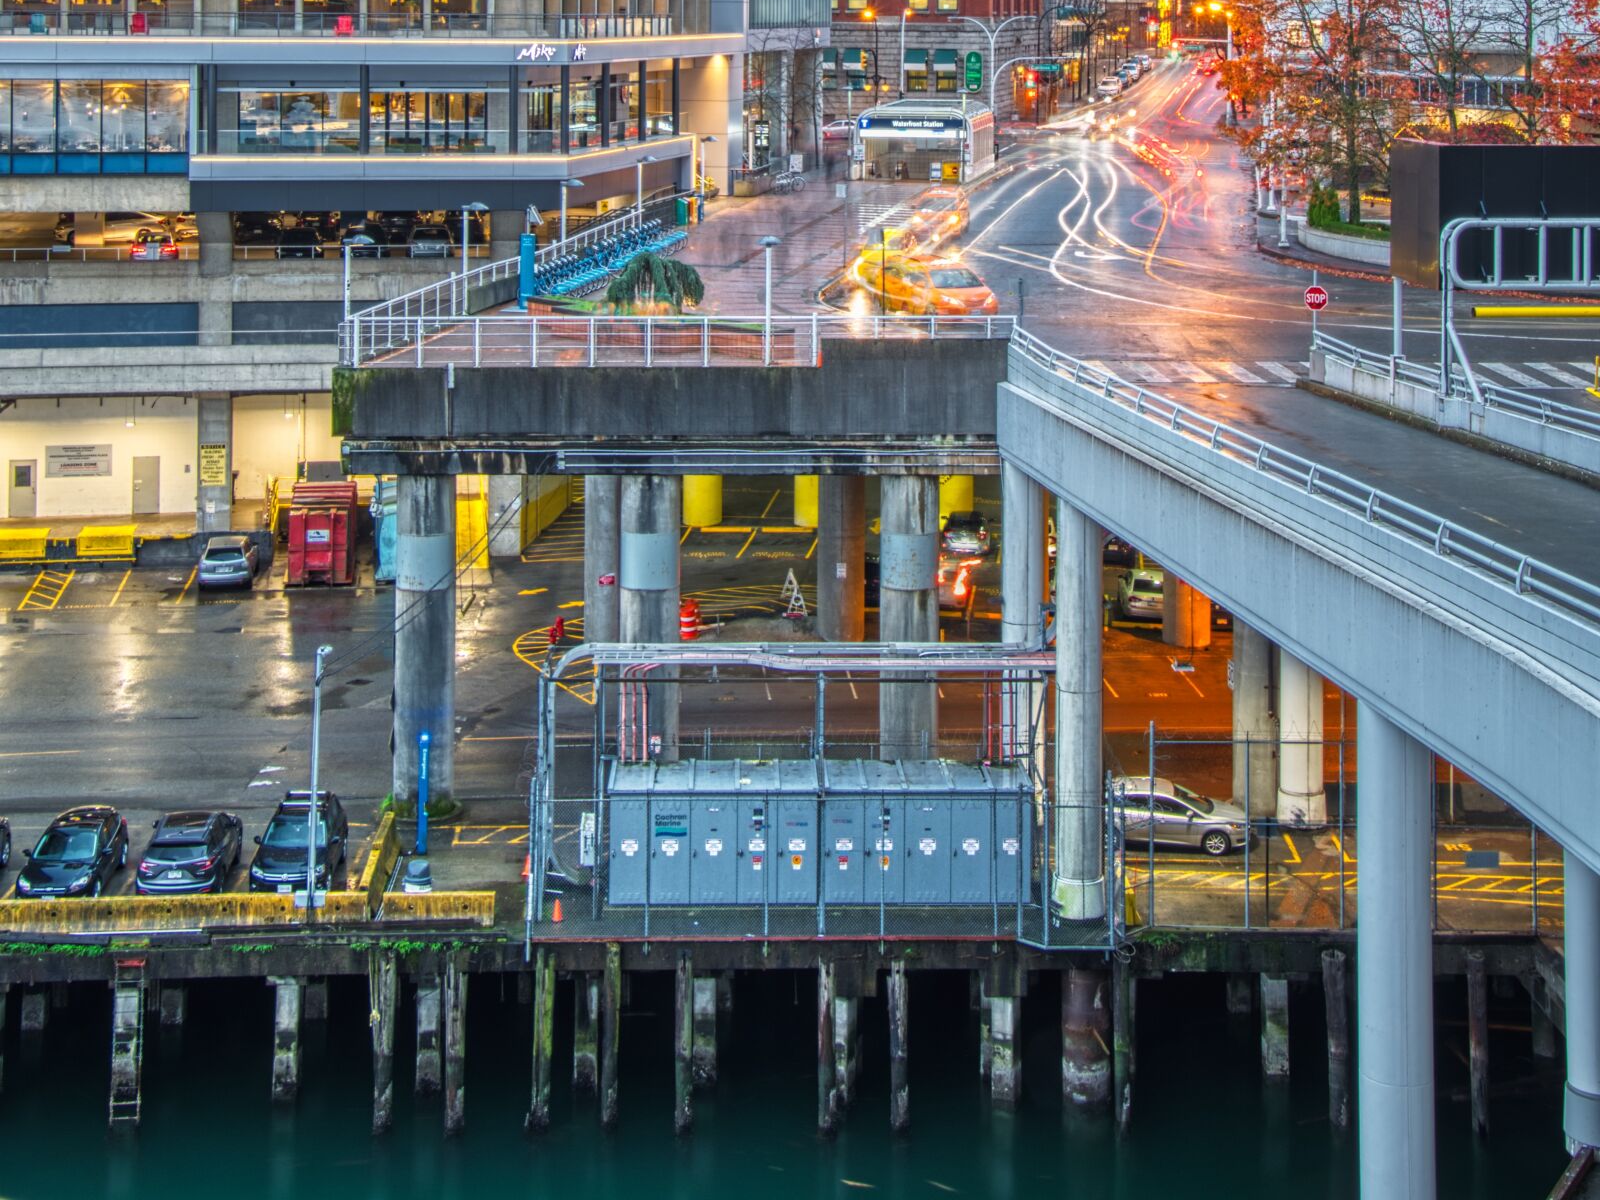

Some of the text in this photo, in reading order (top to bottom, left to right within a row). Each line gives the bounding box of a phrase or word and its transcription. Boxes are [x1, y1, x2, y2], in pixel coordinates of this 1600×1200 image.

[892, 120, 944, 128] Waterfront Station
[1306, 293, 1326, 304] STOP
